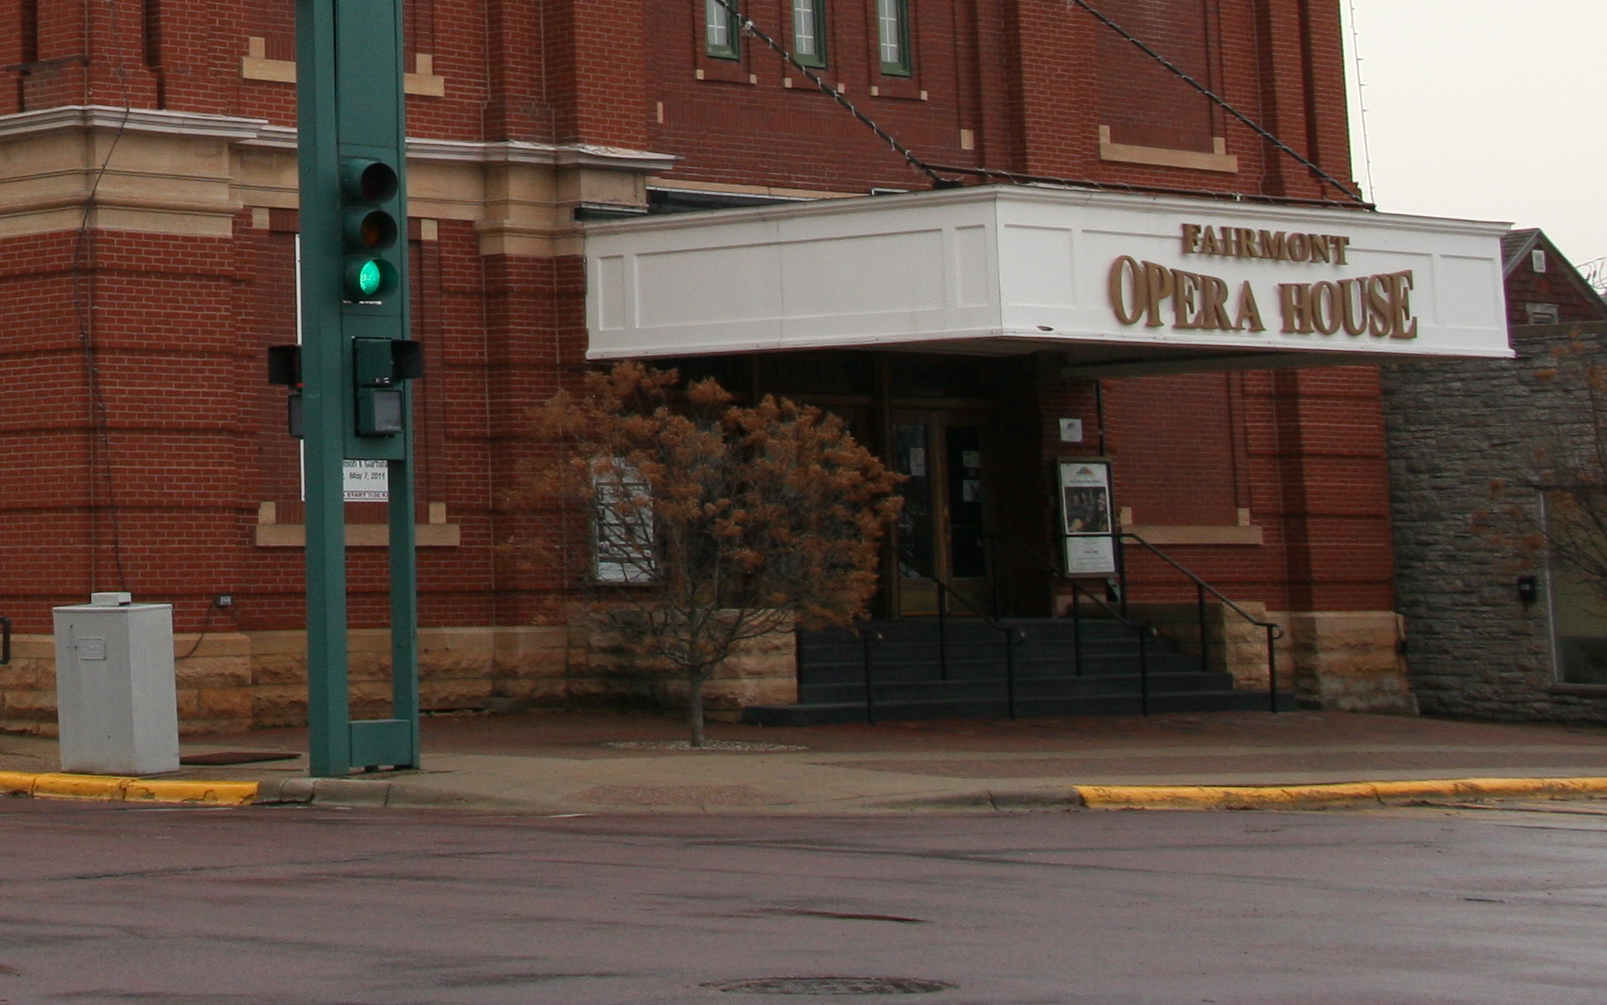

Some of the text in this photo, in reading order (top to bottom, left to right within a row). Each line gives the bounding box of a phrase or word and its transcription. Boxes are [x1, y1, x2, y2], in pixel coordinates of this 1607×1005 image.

[1181, 223, 1350, 265] FAIRMONT
[1109, 254, 1418, 339] OPERA HOUSE
[349, 472, 362, 481] May
[370, 472, 386, 480] 2011
